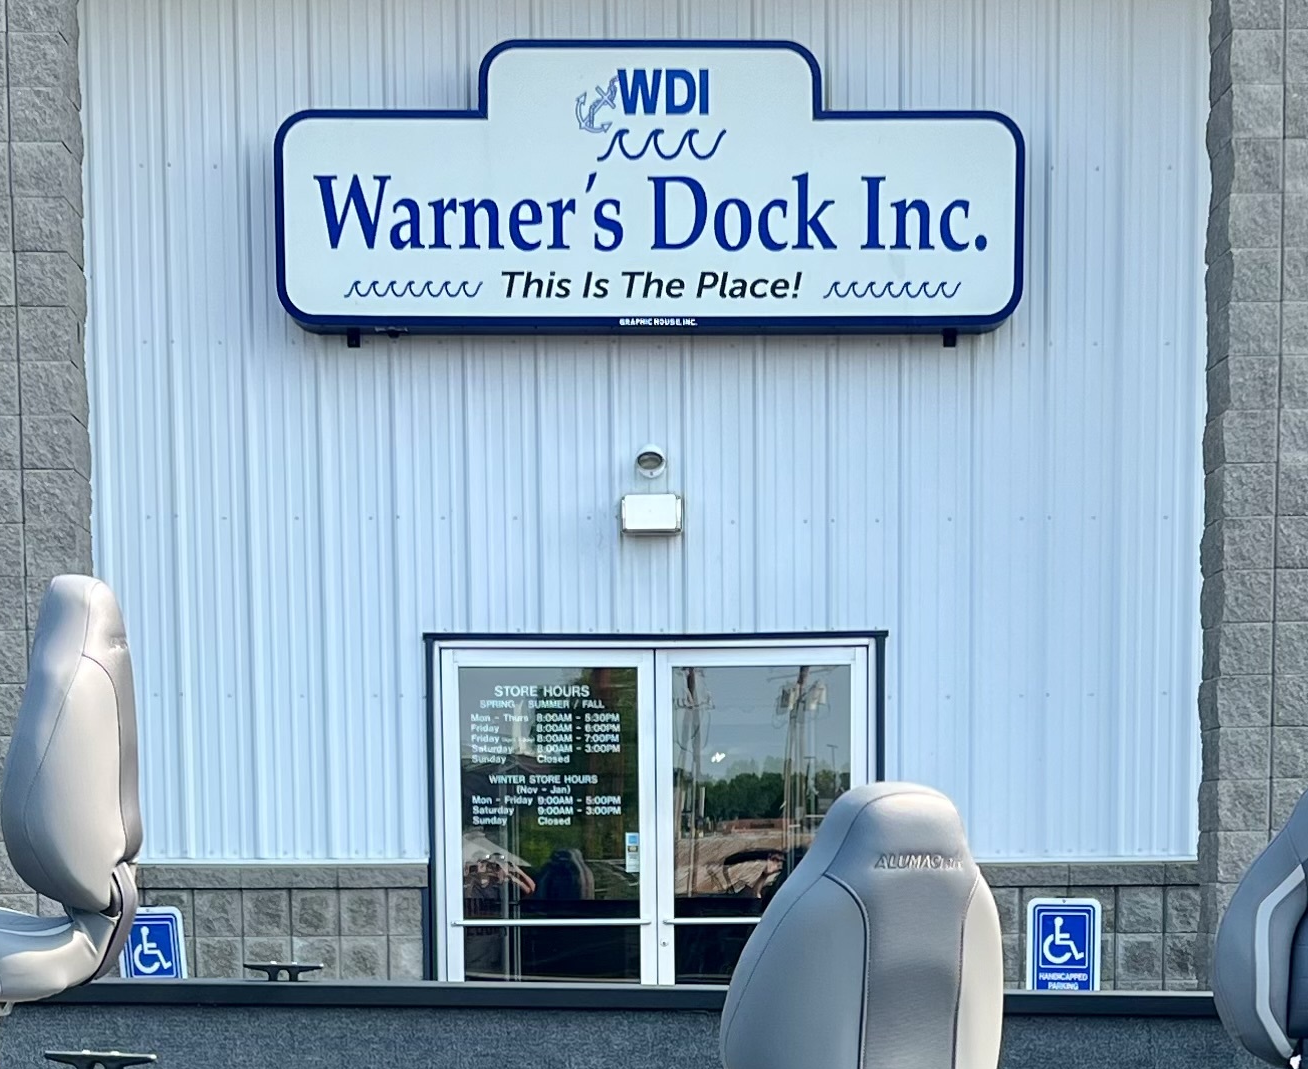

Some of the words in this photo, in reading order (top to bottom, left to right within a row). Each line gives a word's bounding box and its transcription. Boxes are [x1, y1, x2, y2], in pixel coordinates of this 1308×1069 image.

[616, 68, 710, 116] WDI
[313, 171, 623, 252] Warner's
[647, 171, 837, 252] Dock
[859, 175, 989, 252] Inc.
[501, 271, 572, 299] This
[582, 271, 611, 299] Is
[620, 271, 686, 299] The
[696, 271, 803, 299] Place!
[619, 318, 652, 326] GRAPHIC
[494, 685, 538, 697] STORE
[543, 685, 590, 697] HOURS
[479, 700, 515, 709] SPRING
[527, 700, 570, 709] SUMMER
[582, 700, 605, 709] FALL
[471, 713, 491, 722] Mon
[504, 713, 529, 722] Thurs
[471, 724, 500, 734] Friday
[471, 734, 500, 743] Friday
[584, 734, 620, 742] 7:00PM
[471, 744, 514, 754] Saturday
[471, 755, 507, 765] Sunday
[537, 754, 570, 763] Closed
[488, 775, 526, 784] WINTER
[529, 775, 561, 784] STORE
[564, 775, 598, 784] HOURS
[516, 785, 538, 794] (Nov
[550, 785, 571, 794] Jan)
[472, 796, 492, 804] Mon
[504, 795, 533, 806] Friday
[538, 795, 573, 804] 9:00AM
[472, 806, 514, 816] Saturday
[538, 806, 573, 815] 9:00AM
[585, 806, 621, 815] 3:00PM
[472, 816, 507, 826] Sunday
[537, 816, 571, 826] Closed
[1038, 972, 1088, 981] HANDICAPPED
[1048, 981, 1079, 990] PARKING
